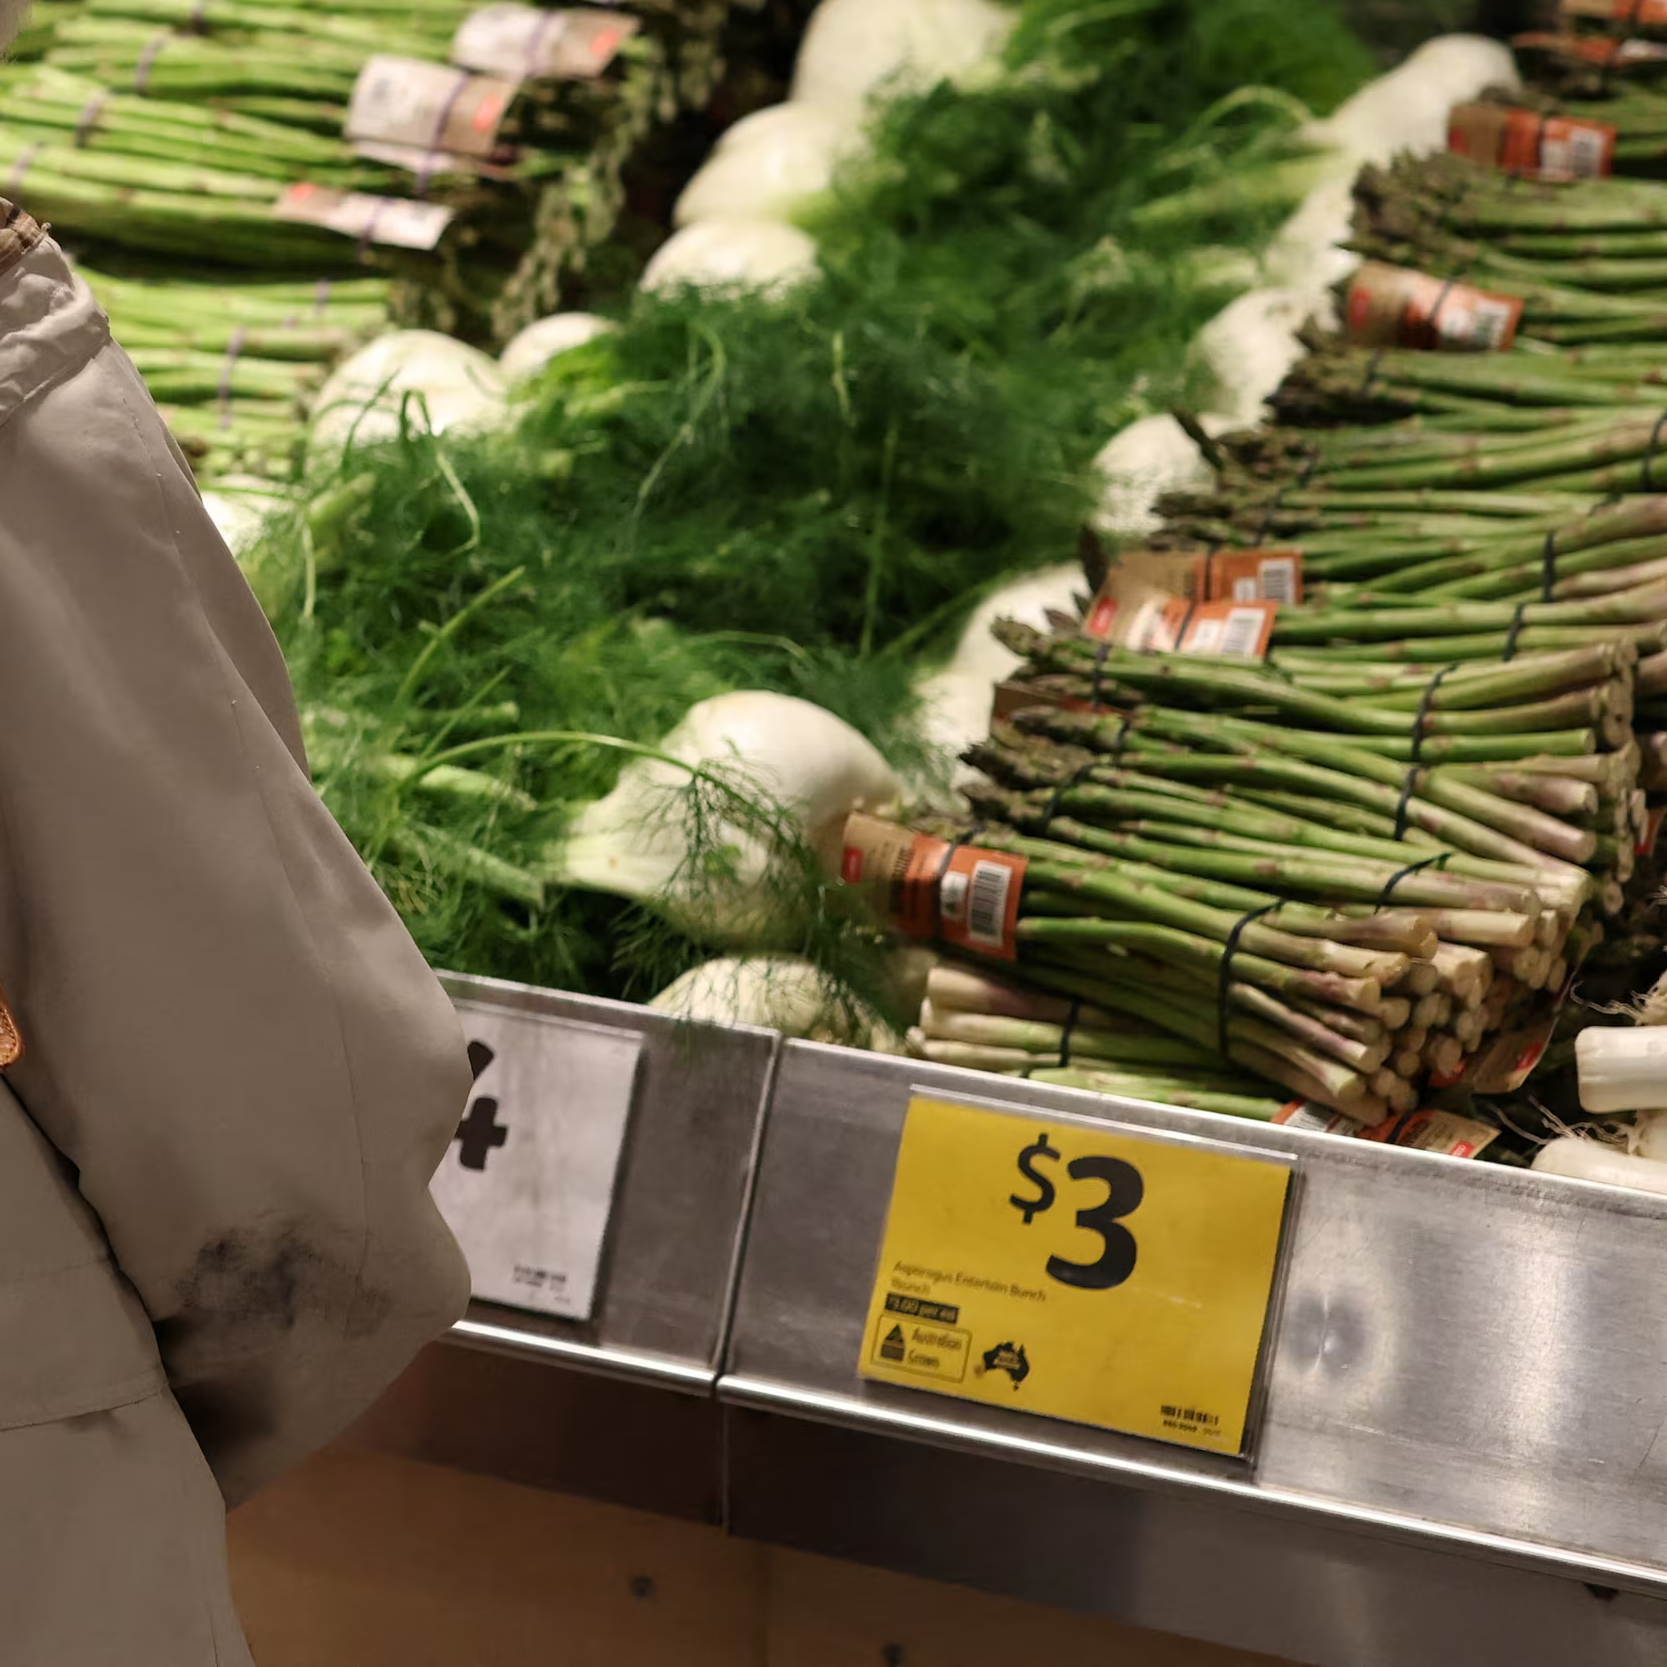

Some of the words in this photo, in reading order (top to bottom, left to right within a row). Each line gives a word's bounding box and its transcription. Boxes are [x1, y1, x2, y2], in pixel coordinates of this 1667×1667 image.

[1009, 1133, 1145, 1290] $3
[894, 1260, 953, 1283] Asparagus
[1009, 1282, 1047, 1302] Bunch
[912, 1326, 963, 1351] Australian
[908, 1348, 940, 1369] Grown
